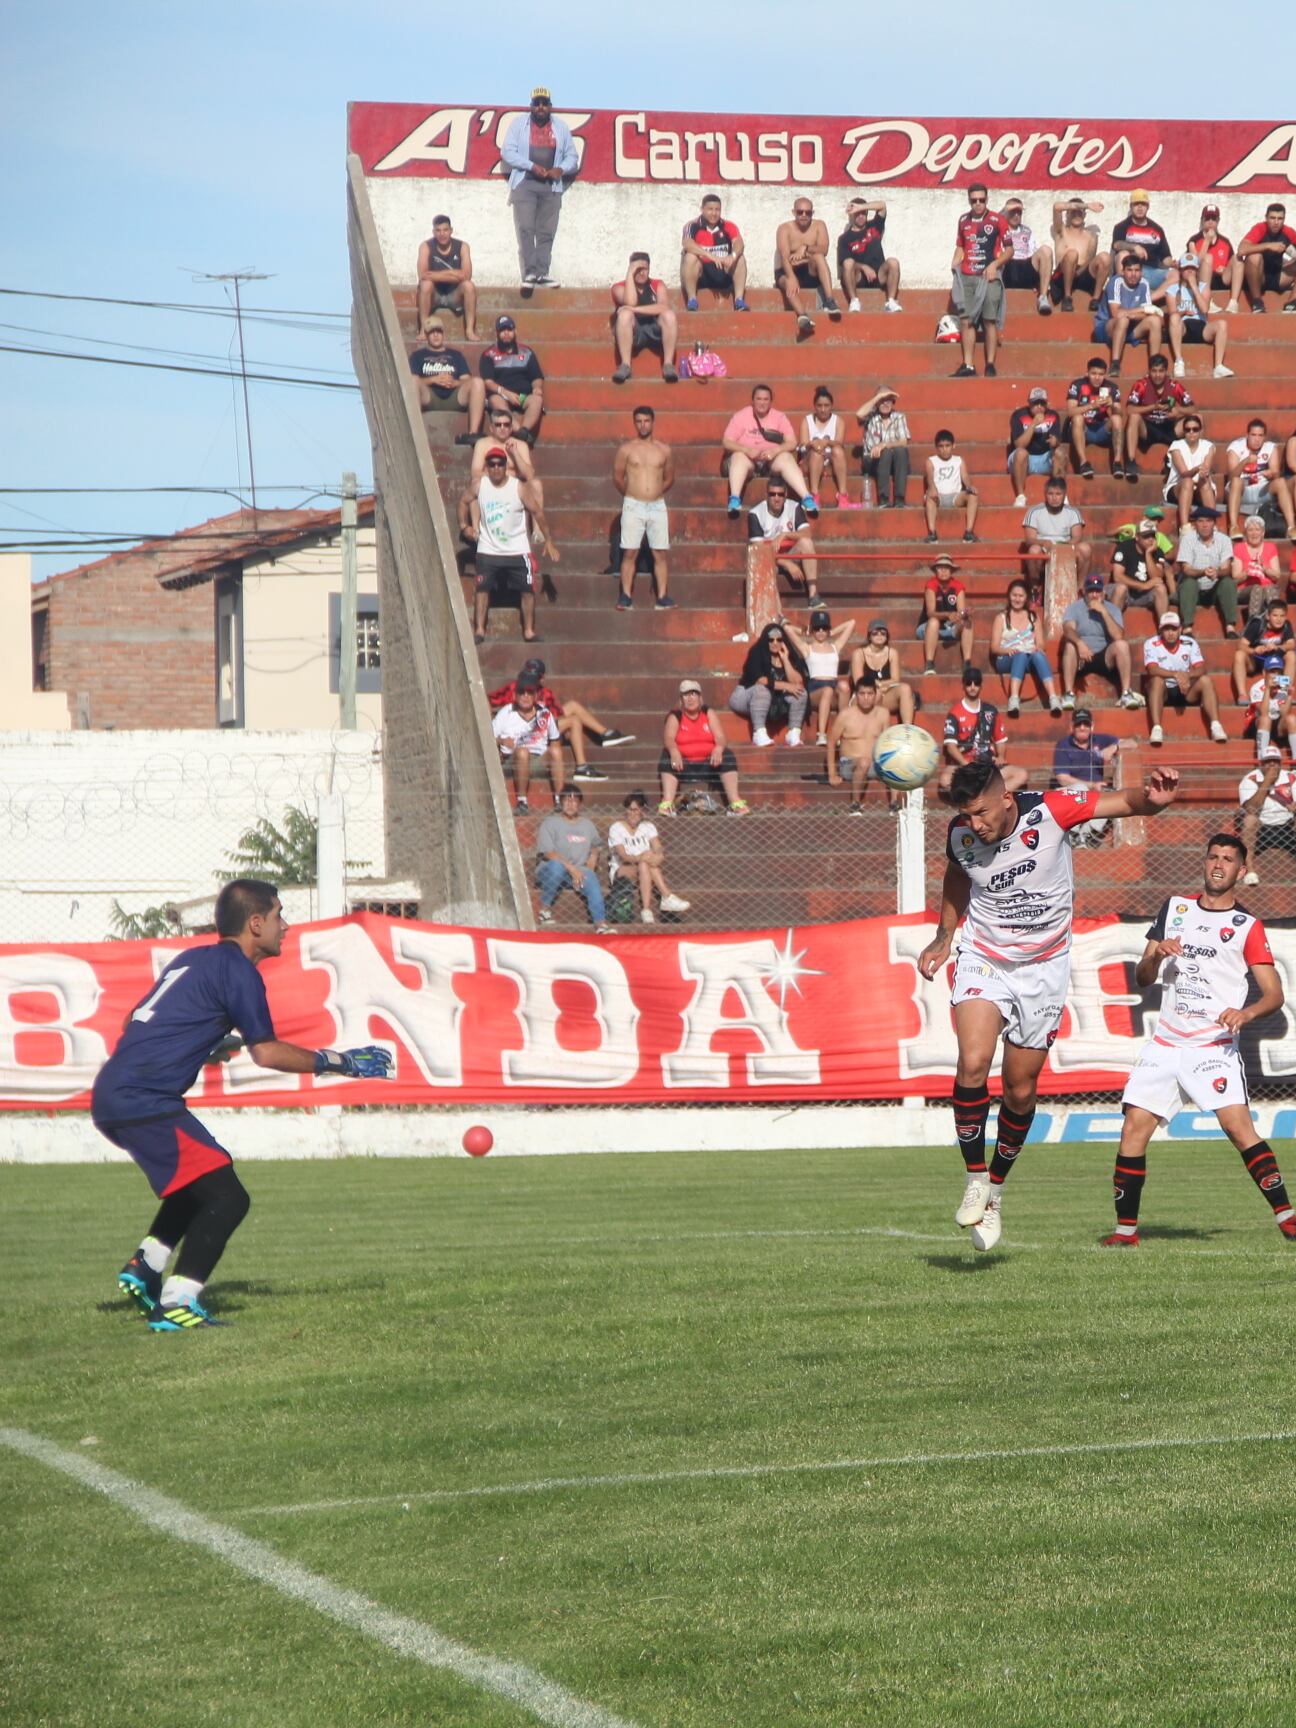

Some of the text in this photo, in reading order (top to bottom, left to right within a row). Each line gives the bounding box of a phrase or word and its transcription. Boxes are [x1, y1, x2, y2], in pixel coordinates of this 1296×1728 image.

[615, 112, 823, 182] Caruso
[843, 119, 1162, 186] Deportes
[990, 860, 1038, 885] PESOS
[994, 878, 1016, 891] SUR
[0, 920, 822, 1104] BNDA
[132, 966, 190, 1022] 1
